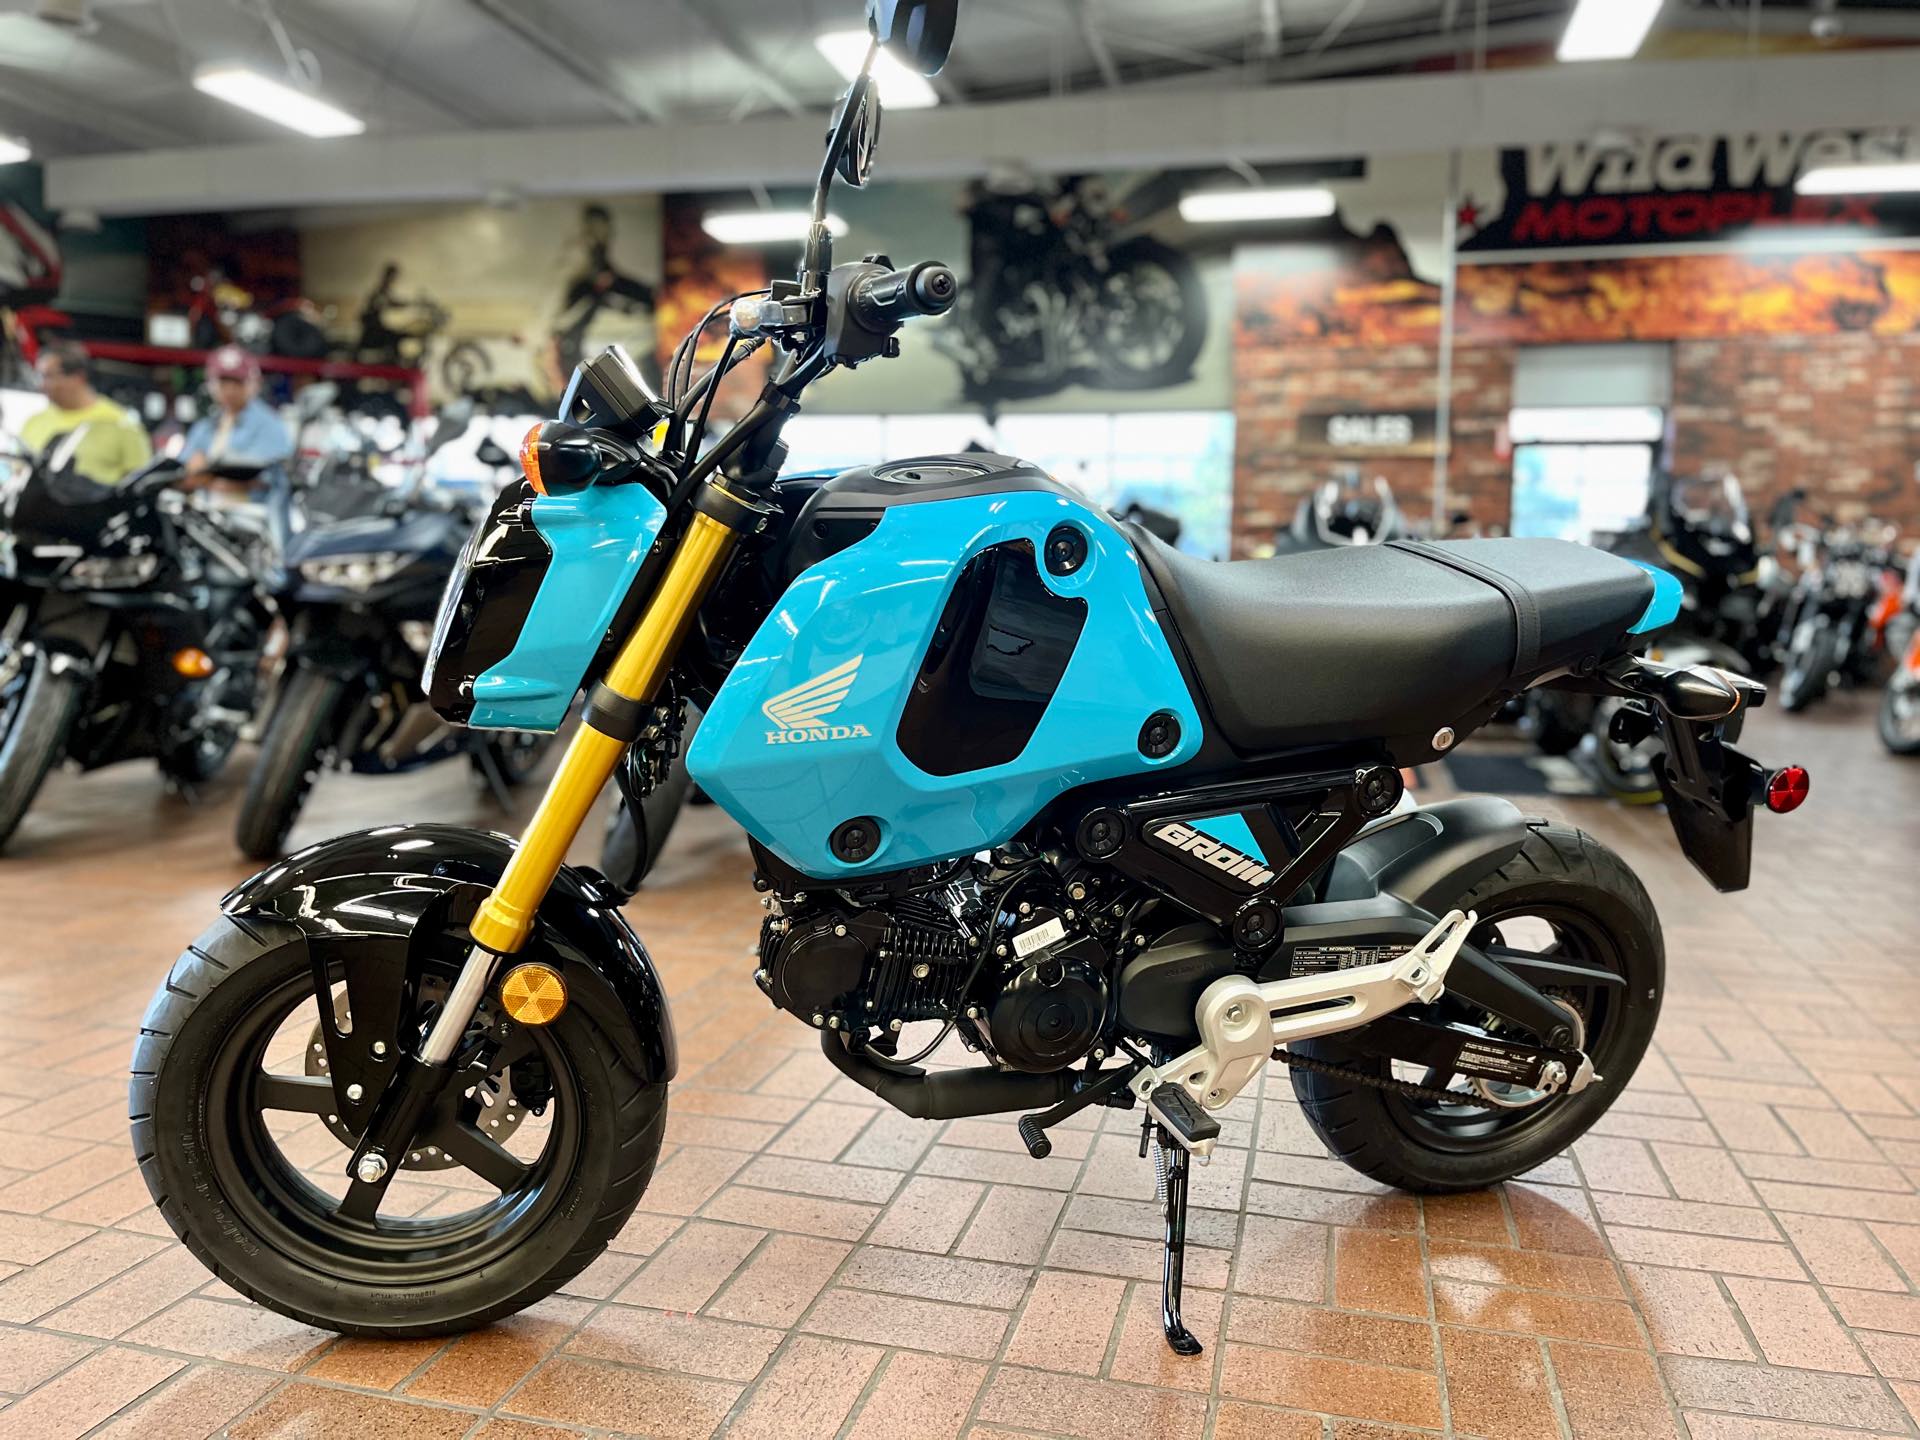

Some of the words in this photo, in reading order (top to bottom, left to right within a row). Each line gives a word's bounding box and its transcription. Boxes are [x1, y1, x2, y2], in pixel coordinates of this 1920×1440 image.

[1727, 127, 1920, 188] Wes
[1510, 193, 1880, 241] MOTOPLEX
[1327, 414, 1413, 446] SALES
[765, 724, 872, 745] HONDA
[1153, 823, 1276, 887] GROM
